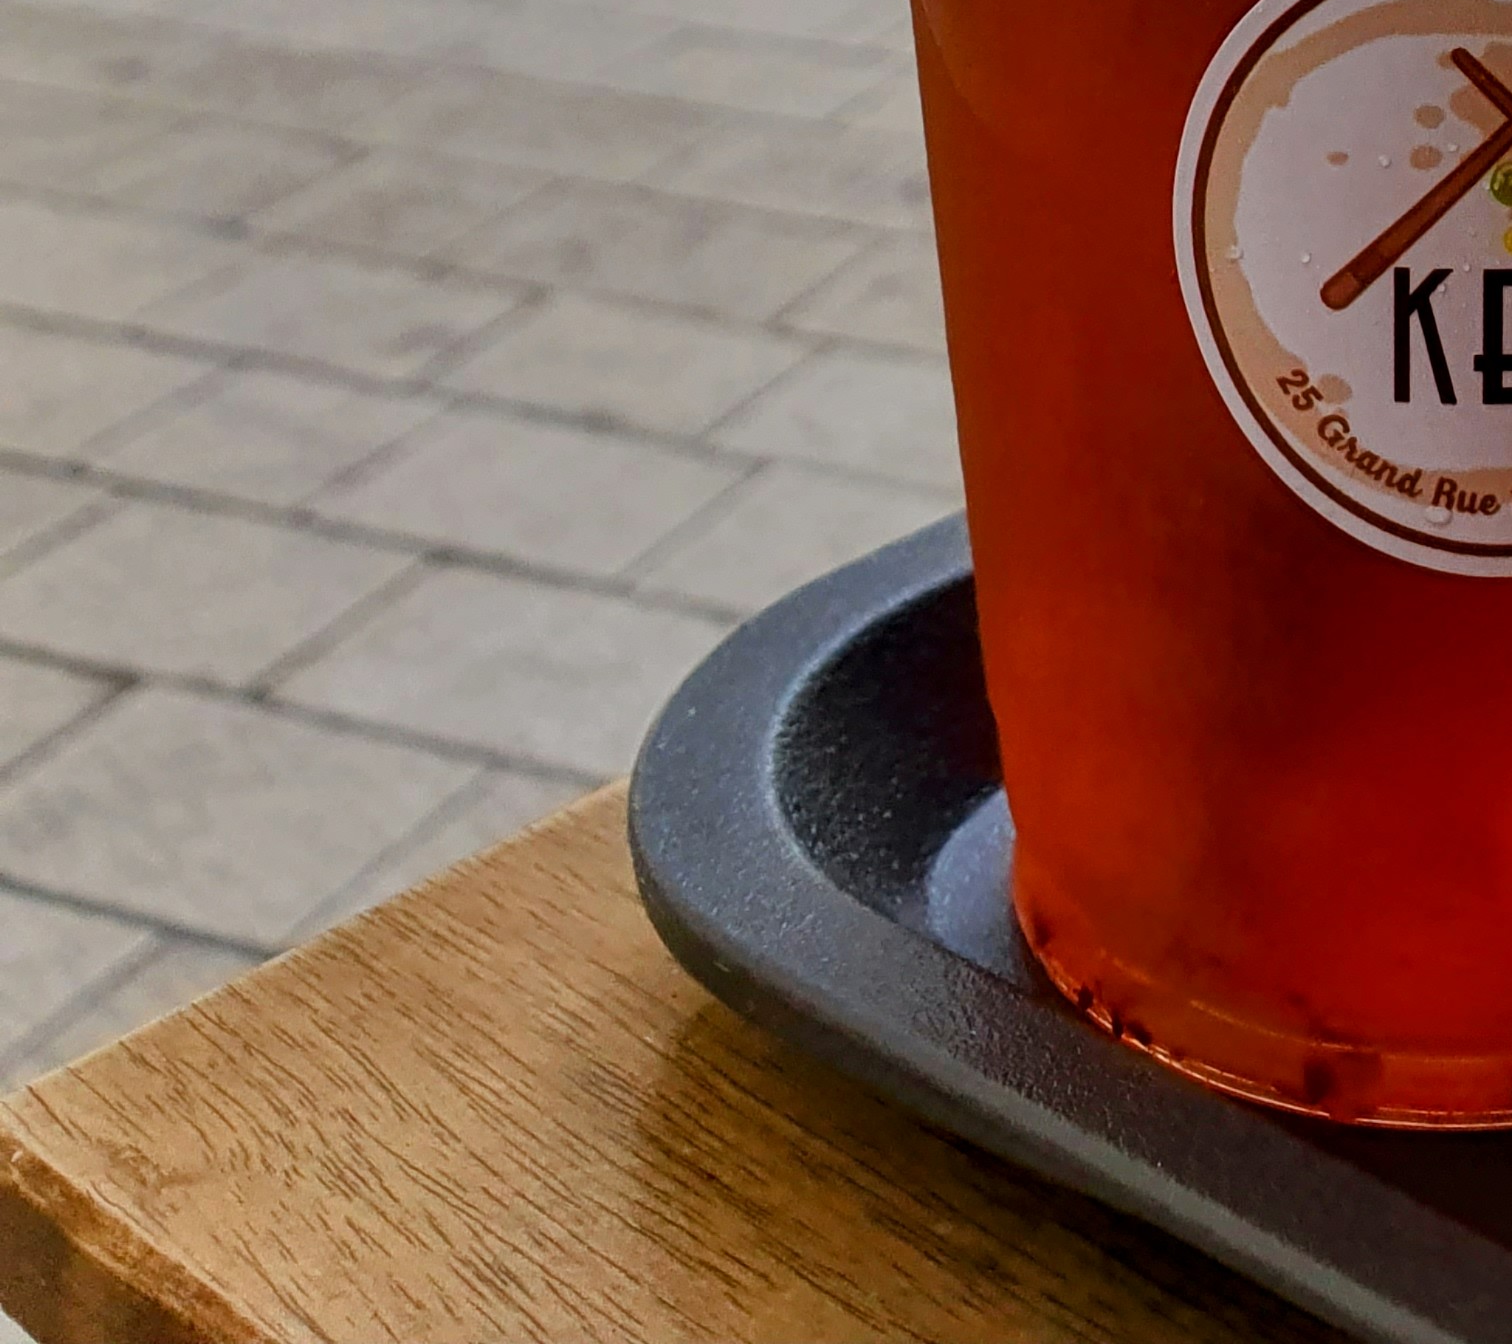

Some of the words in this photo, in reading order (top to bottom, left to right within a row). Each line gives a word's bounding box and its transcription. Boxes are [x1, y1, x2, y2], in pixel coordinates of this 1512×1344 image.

[1276, 369, 1324, 411] 25
[1317, 414, 1423, 498] Grand
[1431, 477, 1501, 515] Rue
